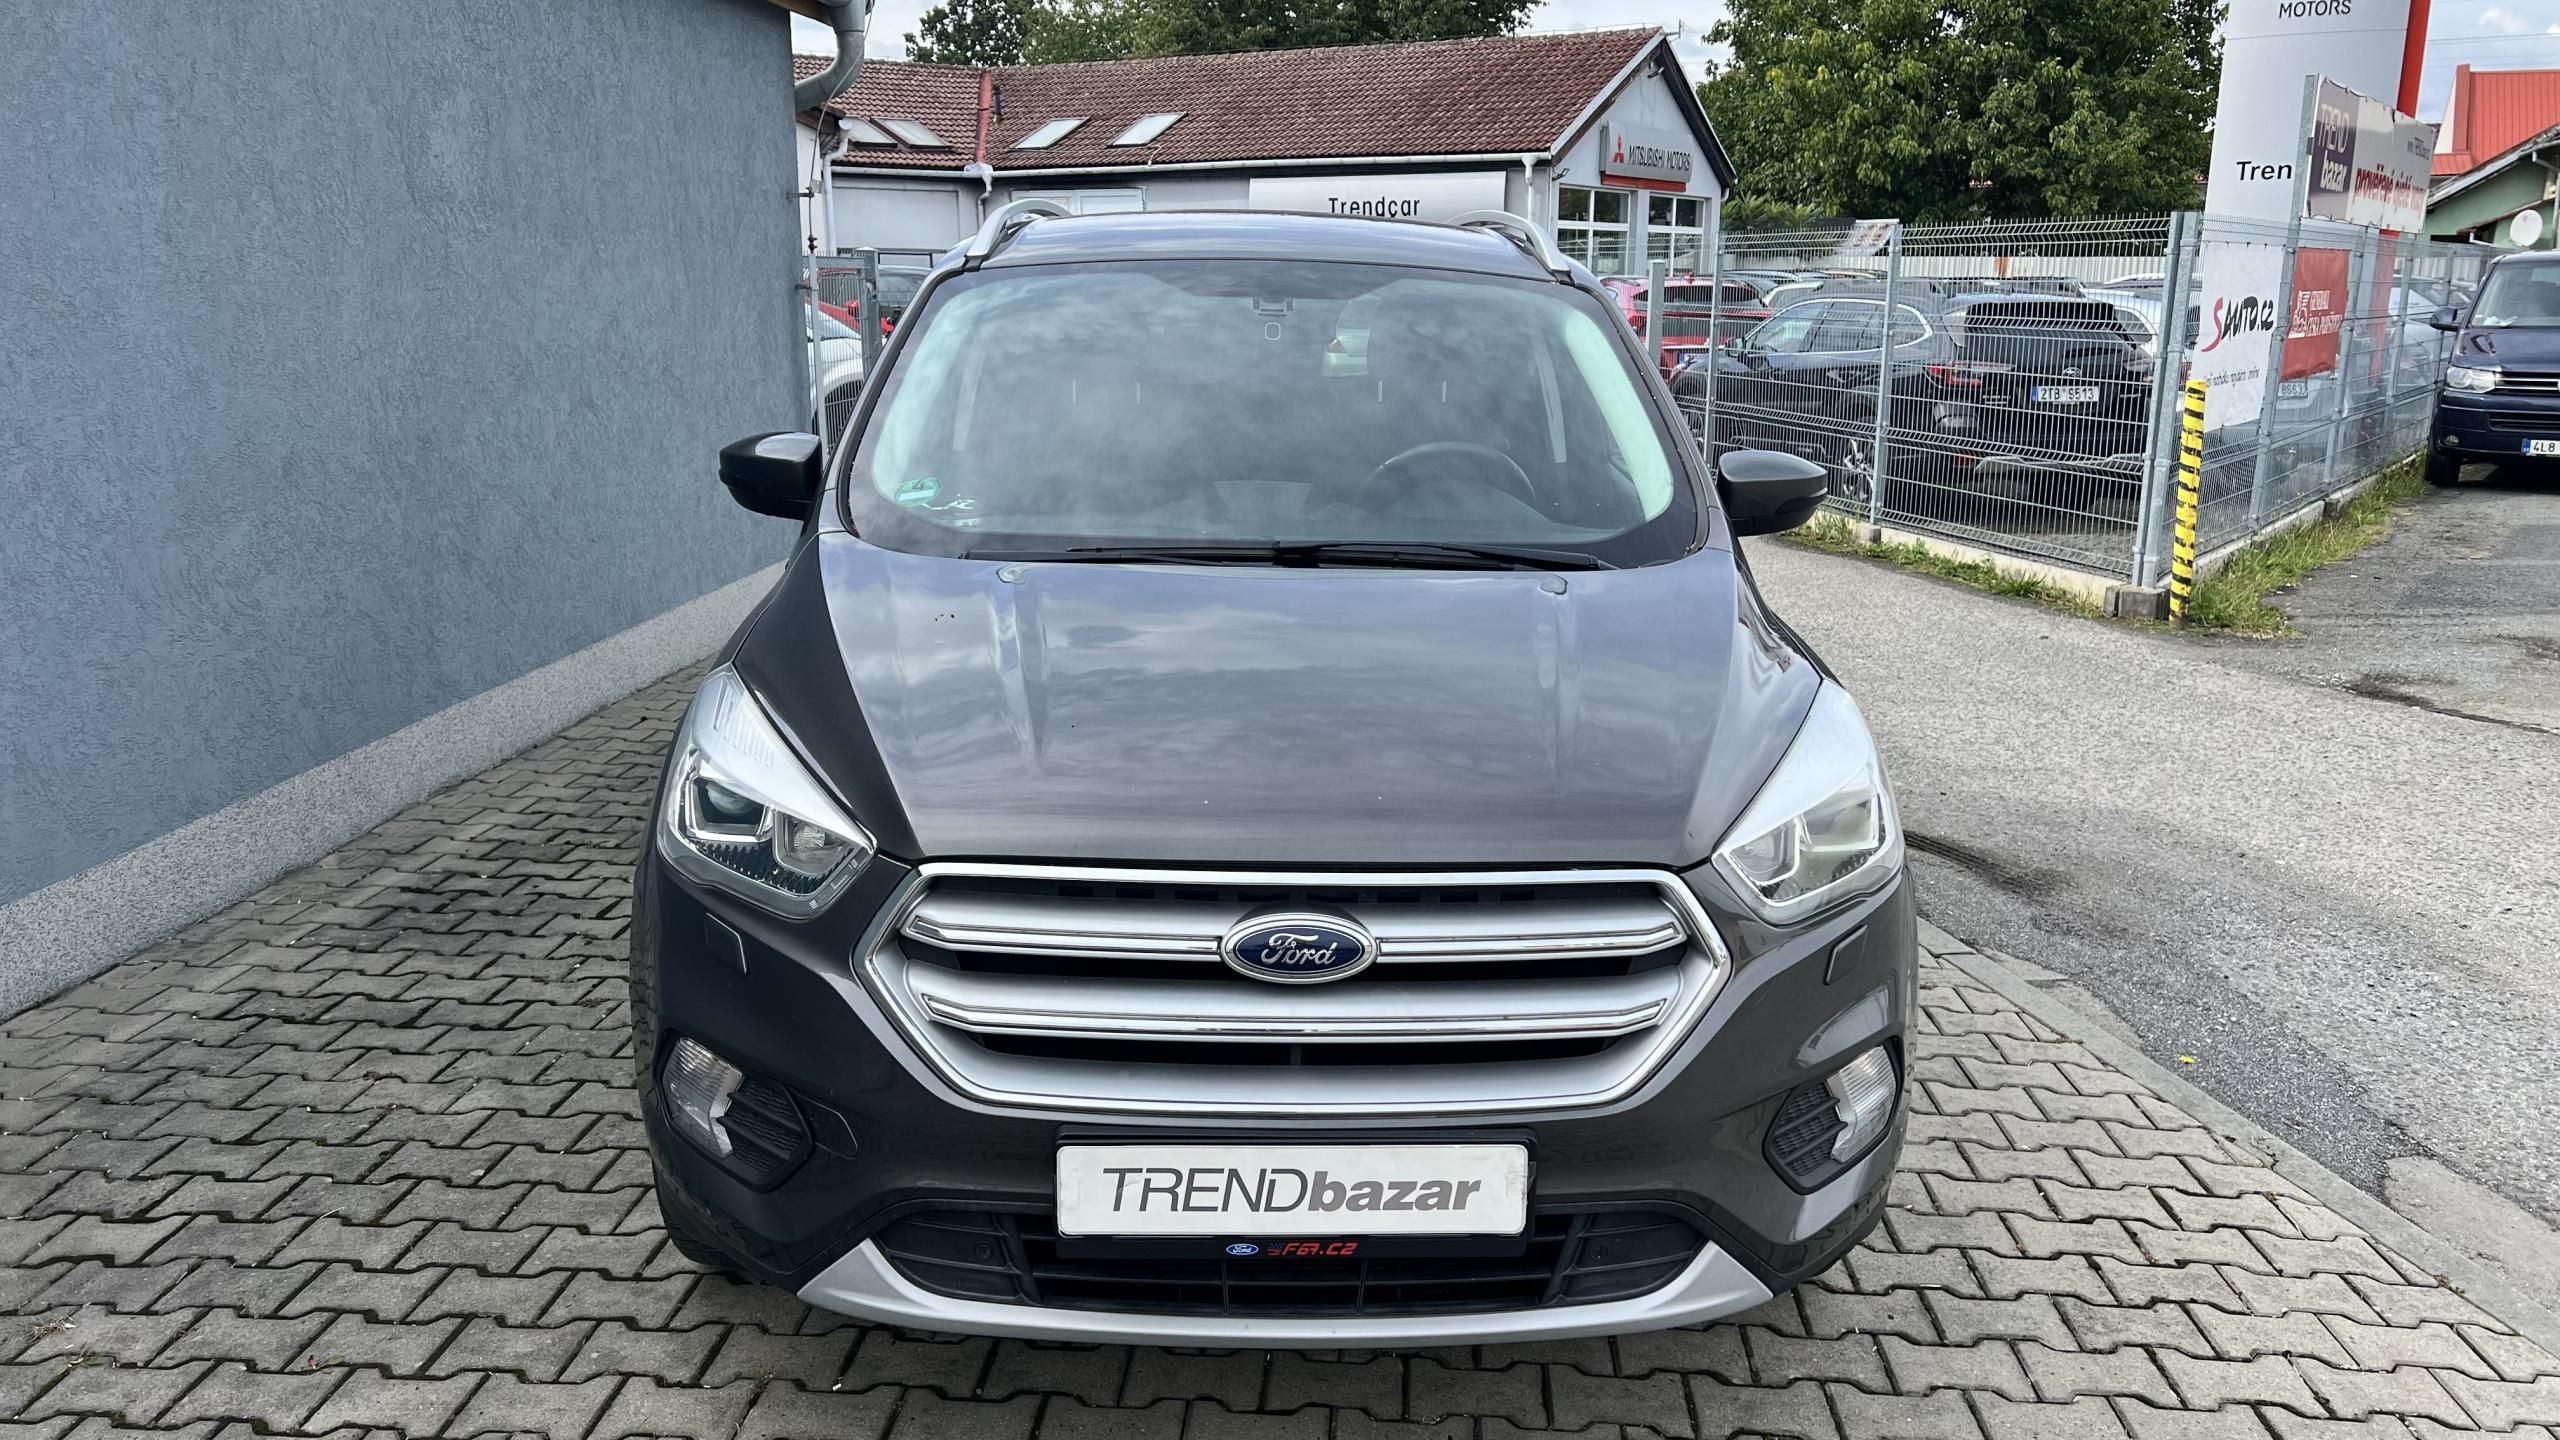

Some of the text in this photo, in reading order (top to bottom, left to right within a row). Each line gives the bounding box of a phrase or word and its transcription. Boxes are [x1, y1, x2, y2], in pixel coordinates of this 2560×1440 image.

[2278, 0, 2352, 19] MOTORS
[2317, 103, 2350, 154] TREND
[1628, 145, 1691, 172] MITSUBISHI MOTORS
[2319, 149, 2349, 192] bazar
[1261, 932, 1338, 965] Ford
[1103, 1168, 1482, 1213] TRENDbazar
